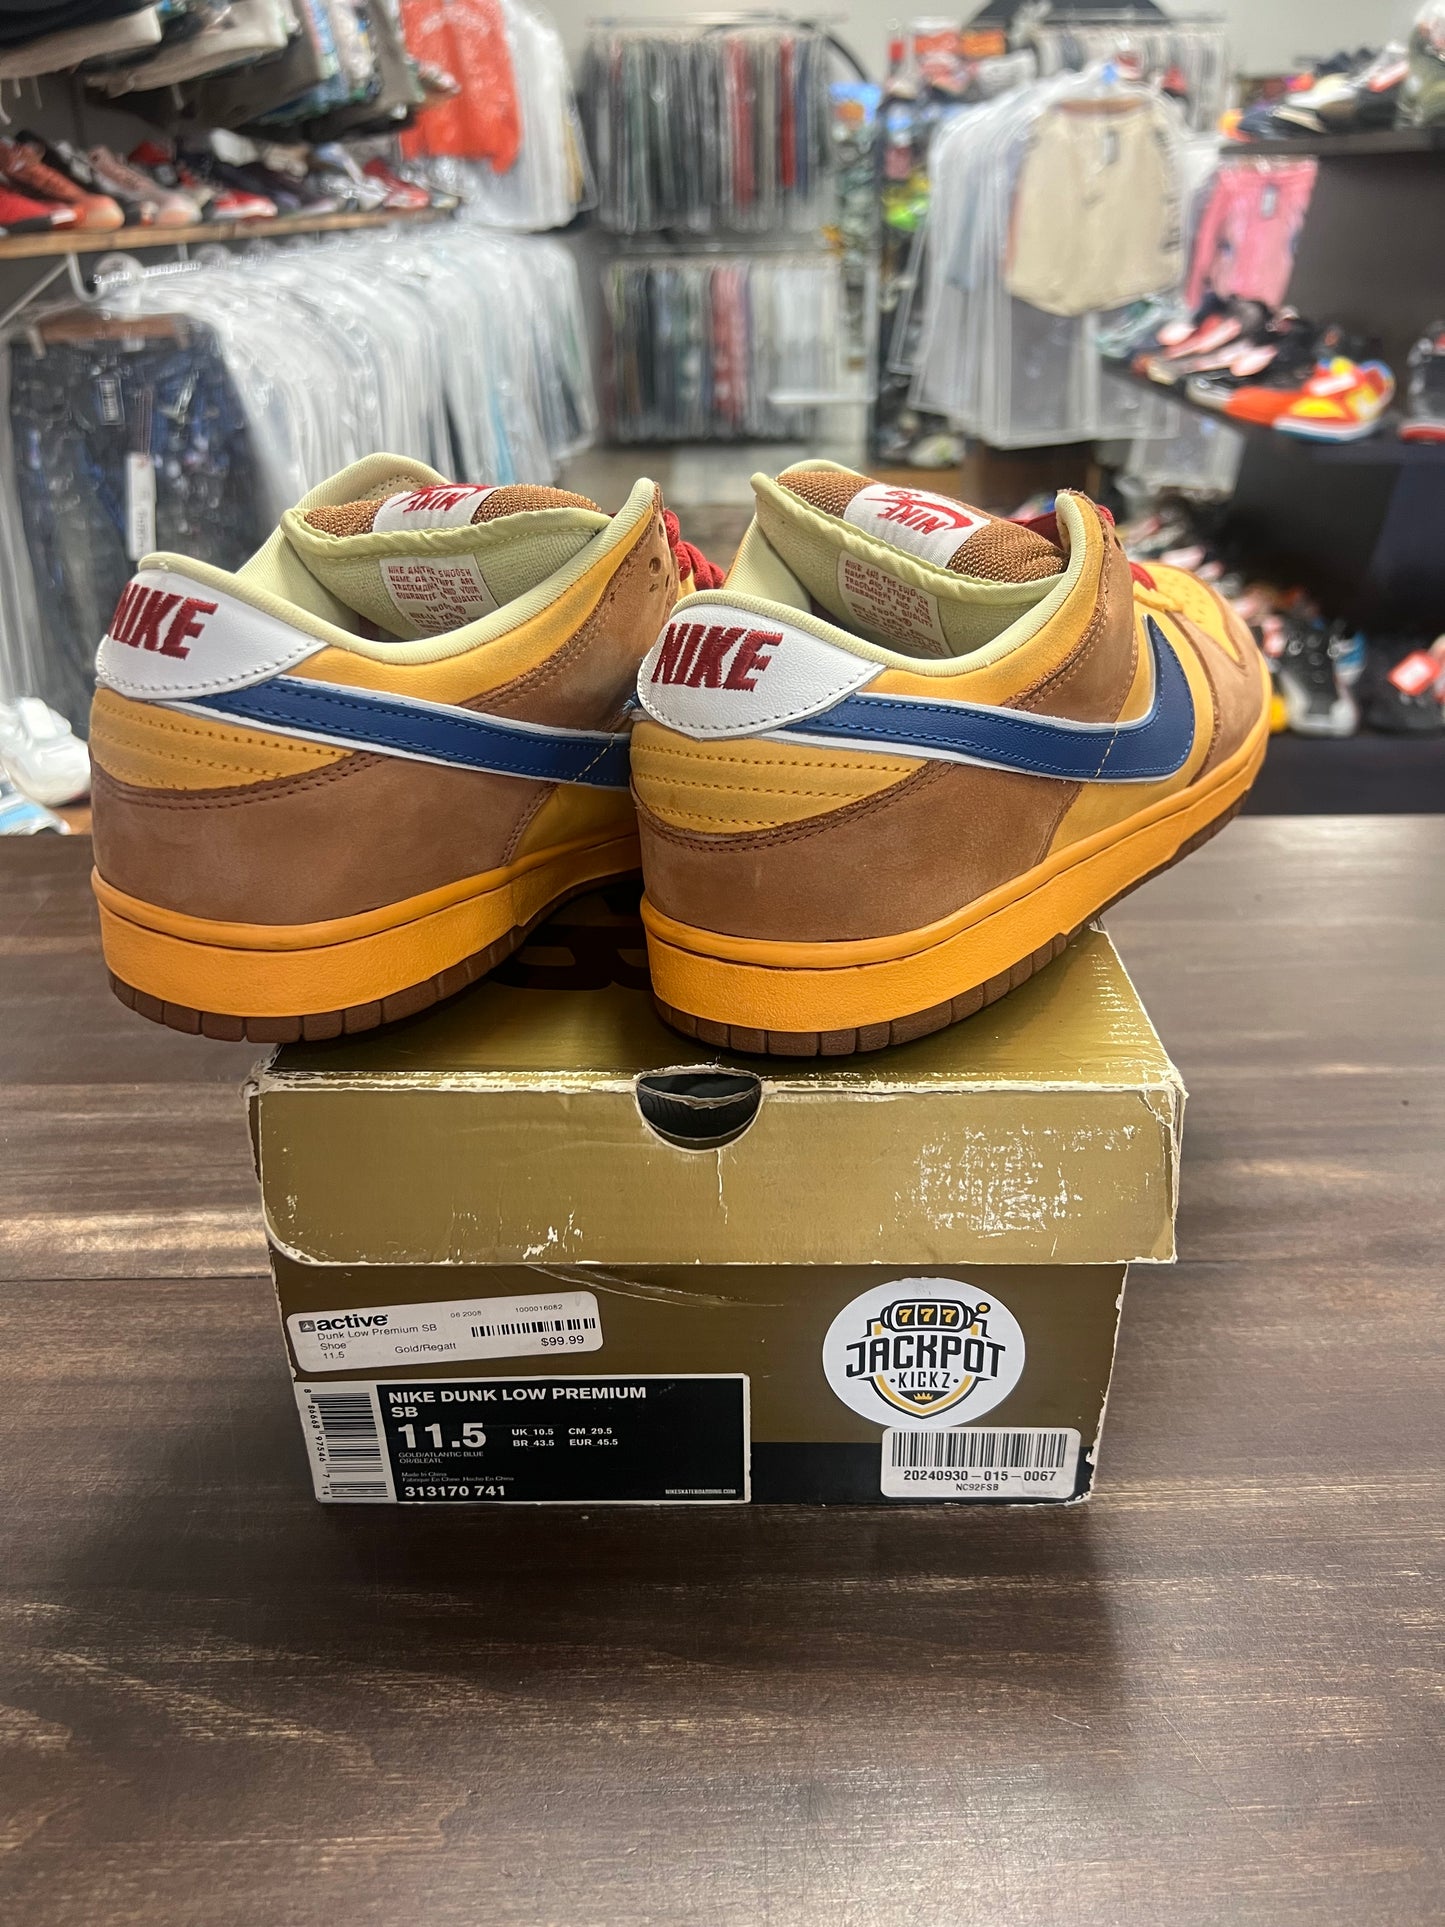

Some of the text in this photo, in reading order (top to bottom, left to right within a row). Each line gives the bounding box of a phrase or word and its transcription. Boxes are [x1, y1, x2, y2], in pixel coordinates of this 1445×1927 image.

[877, 502, 949, 535] NIKE
[109, 580, 219, 660] NIKE
[651, 622, 783, 692] NIKE
[515, 1303, 563, 1313] 1000016082
[316, 1314, 388, 1331] active
[317, 1323, 437, 1341] Dunk Low Premium SB
[541, 1334, 584, 1347] $99.99
[320, 1342, 347, 1351] Shoe
[323, 1351, 345, 1359] 11.5
[394, 1342, 457, 1354] Gold/Regatt
[845, 1334, 1007, 1379] JACKPOT
[898, 1371, 950, 1389] KICKZ
[388, 1386, 647, 1404] NIKE DUNK LOW PREMIUM
[391, 1406, 419, 1418] SB
[397, 1422, 487, 1449] 11.5
[404, 1485, 505, 1497] 313170 741
[955, 1483, 999, 1491] NC92FSB
